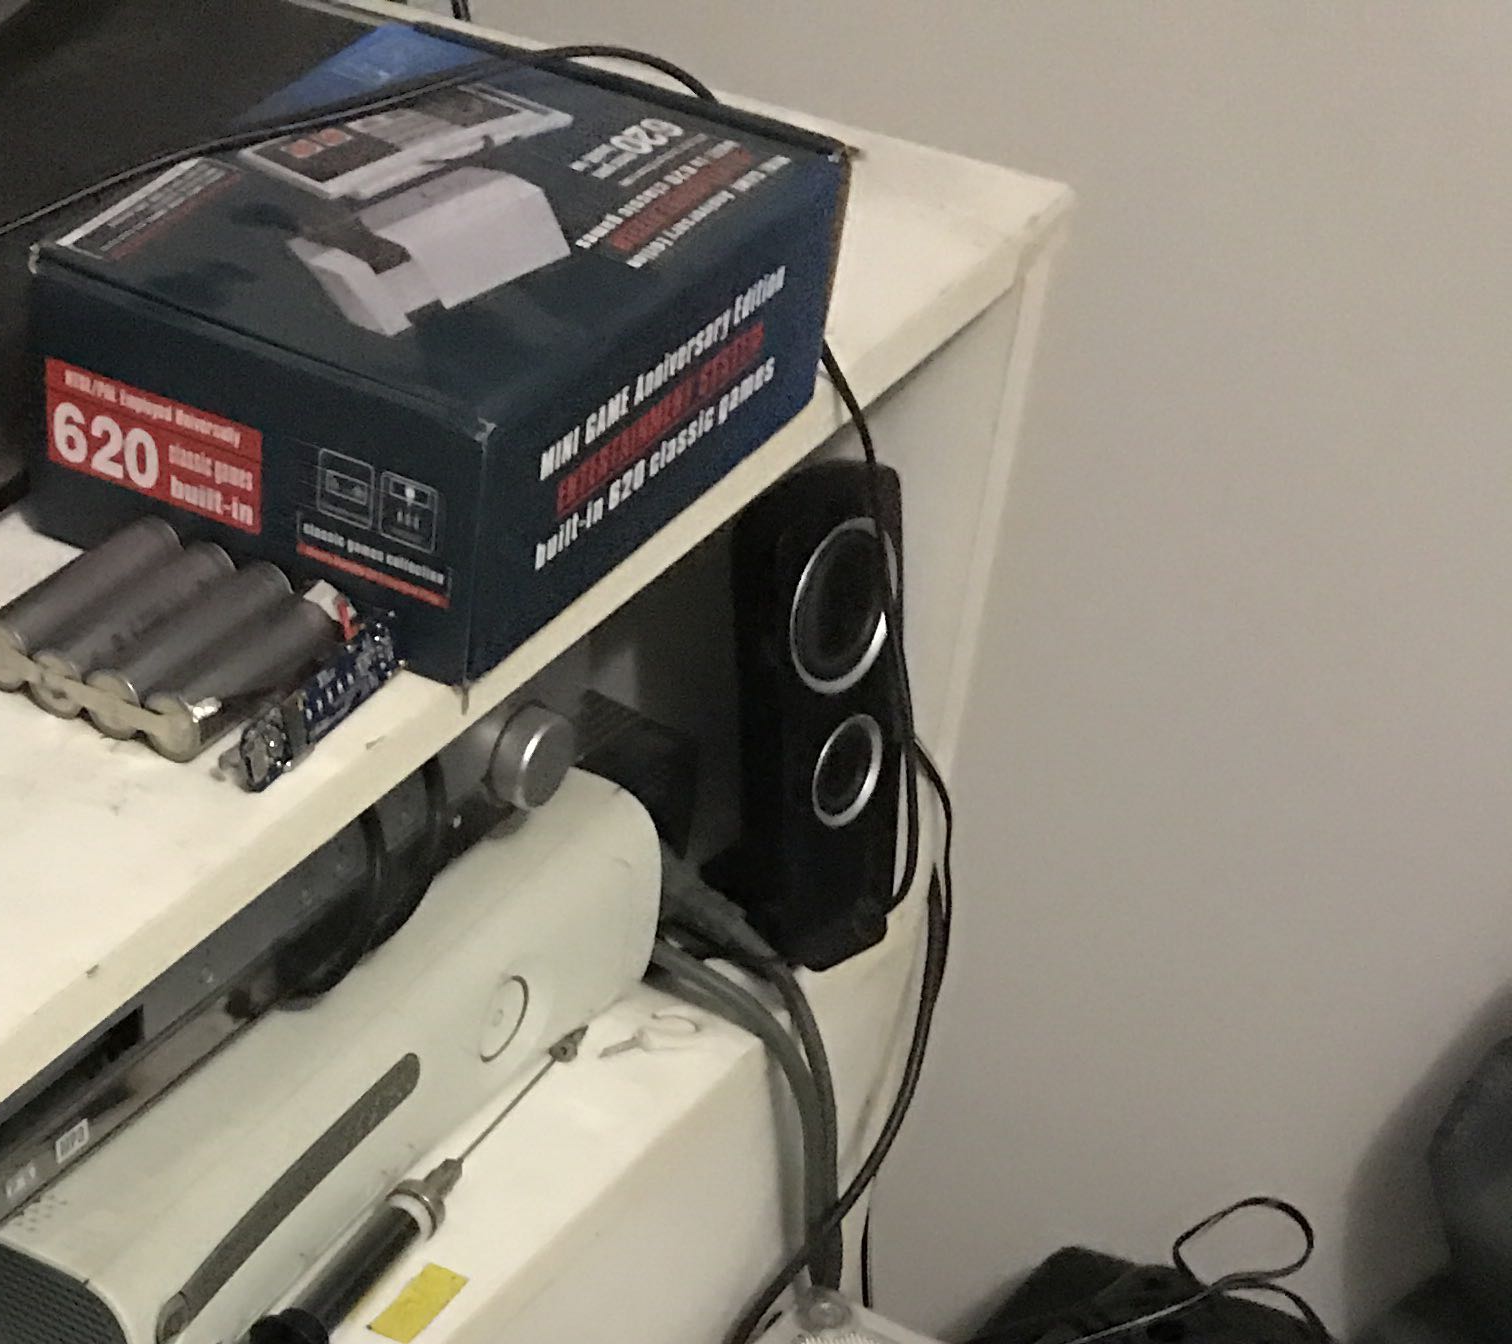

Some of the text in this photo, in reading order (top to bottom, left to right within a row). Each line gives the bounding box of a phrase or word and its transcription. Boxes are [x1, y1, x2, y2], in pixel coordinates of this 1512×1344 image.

[53, 402, 160, 489] 620
[539, 265, 786, 481] MINI GAME Anniversary Edition
[170, 475, 254, 526] built-in
[535, 356, 776, 571] built-in 620 classic games
